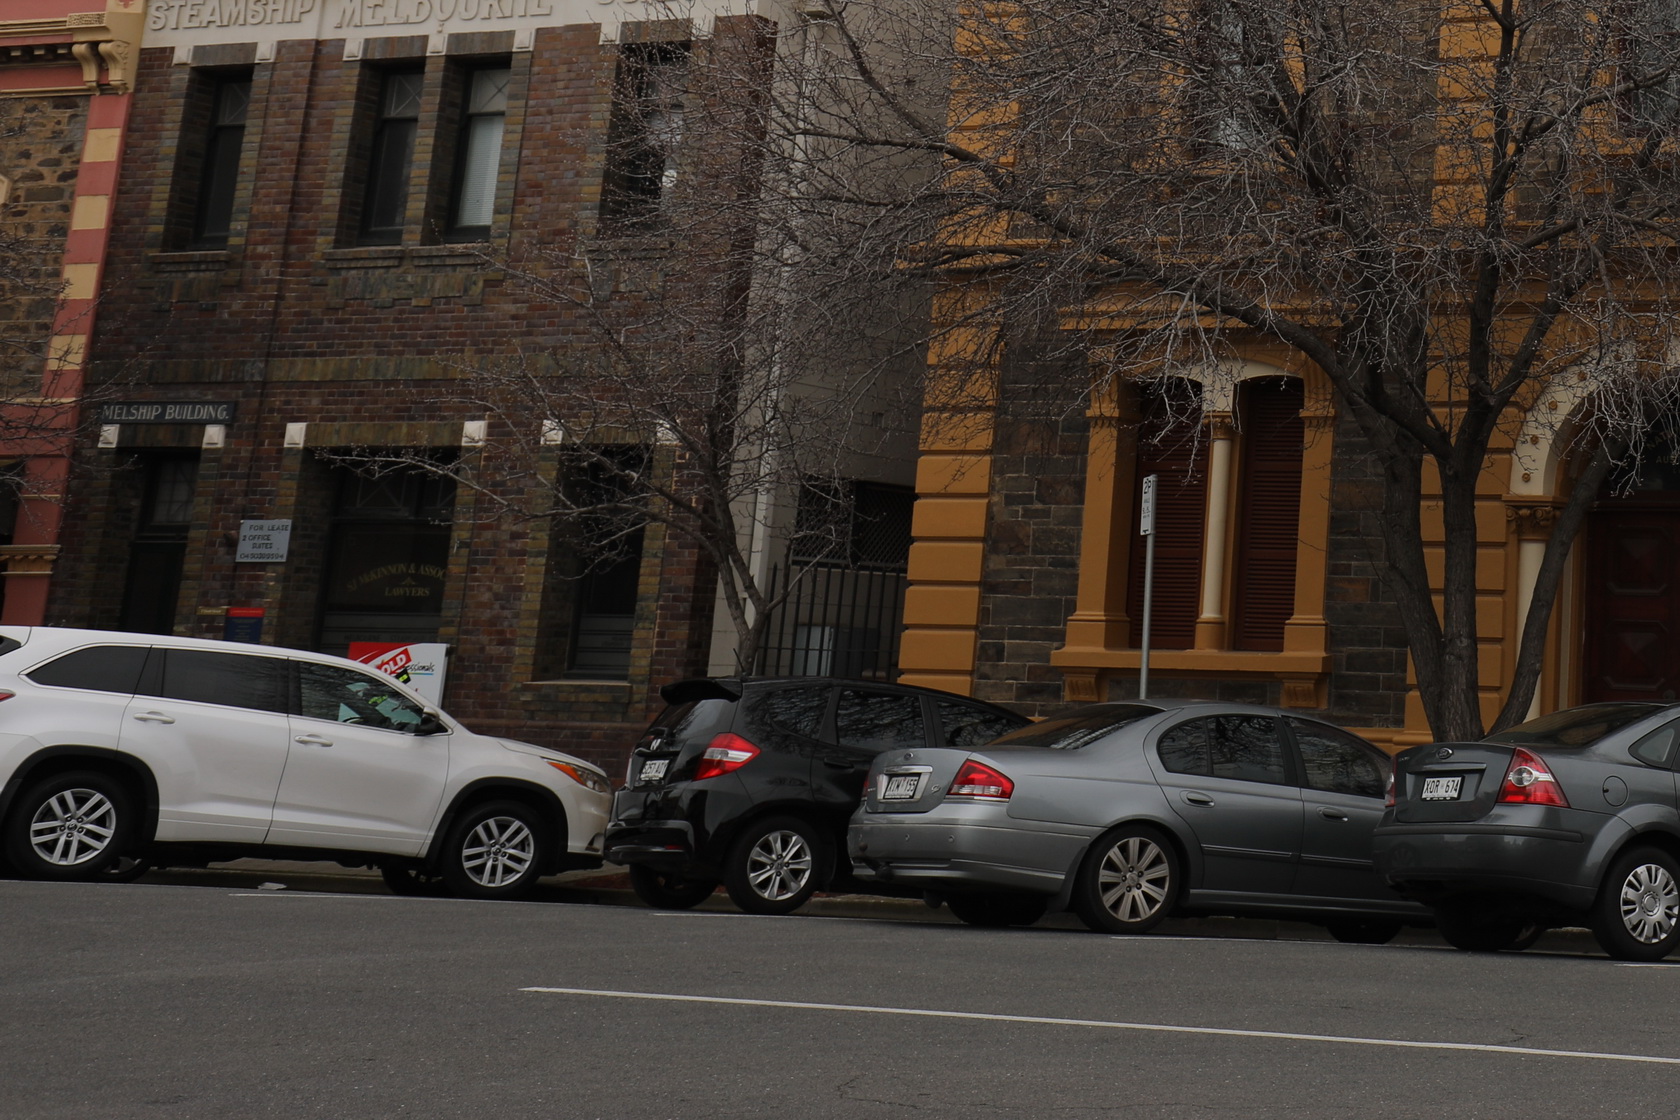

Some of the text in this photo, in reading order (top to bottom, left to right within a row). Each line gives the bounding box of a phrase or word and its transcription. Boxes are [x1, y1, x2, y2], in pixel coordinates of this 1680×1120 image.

[102, 404, 230, 420] MELSHIP BUILDING.
[408, 563, 416, 574] &
[384, 586, 431, 597] LAWYERS
[380, 653, 407, 675] OLD
[1445, 779, 1460, 794] 674
